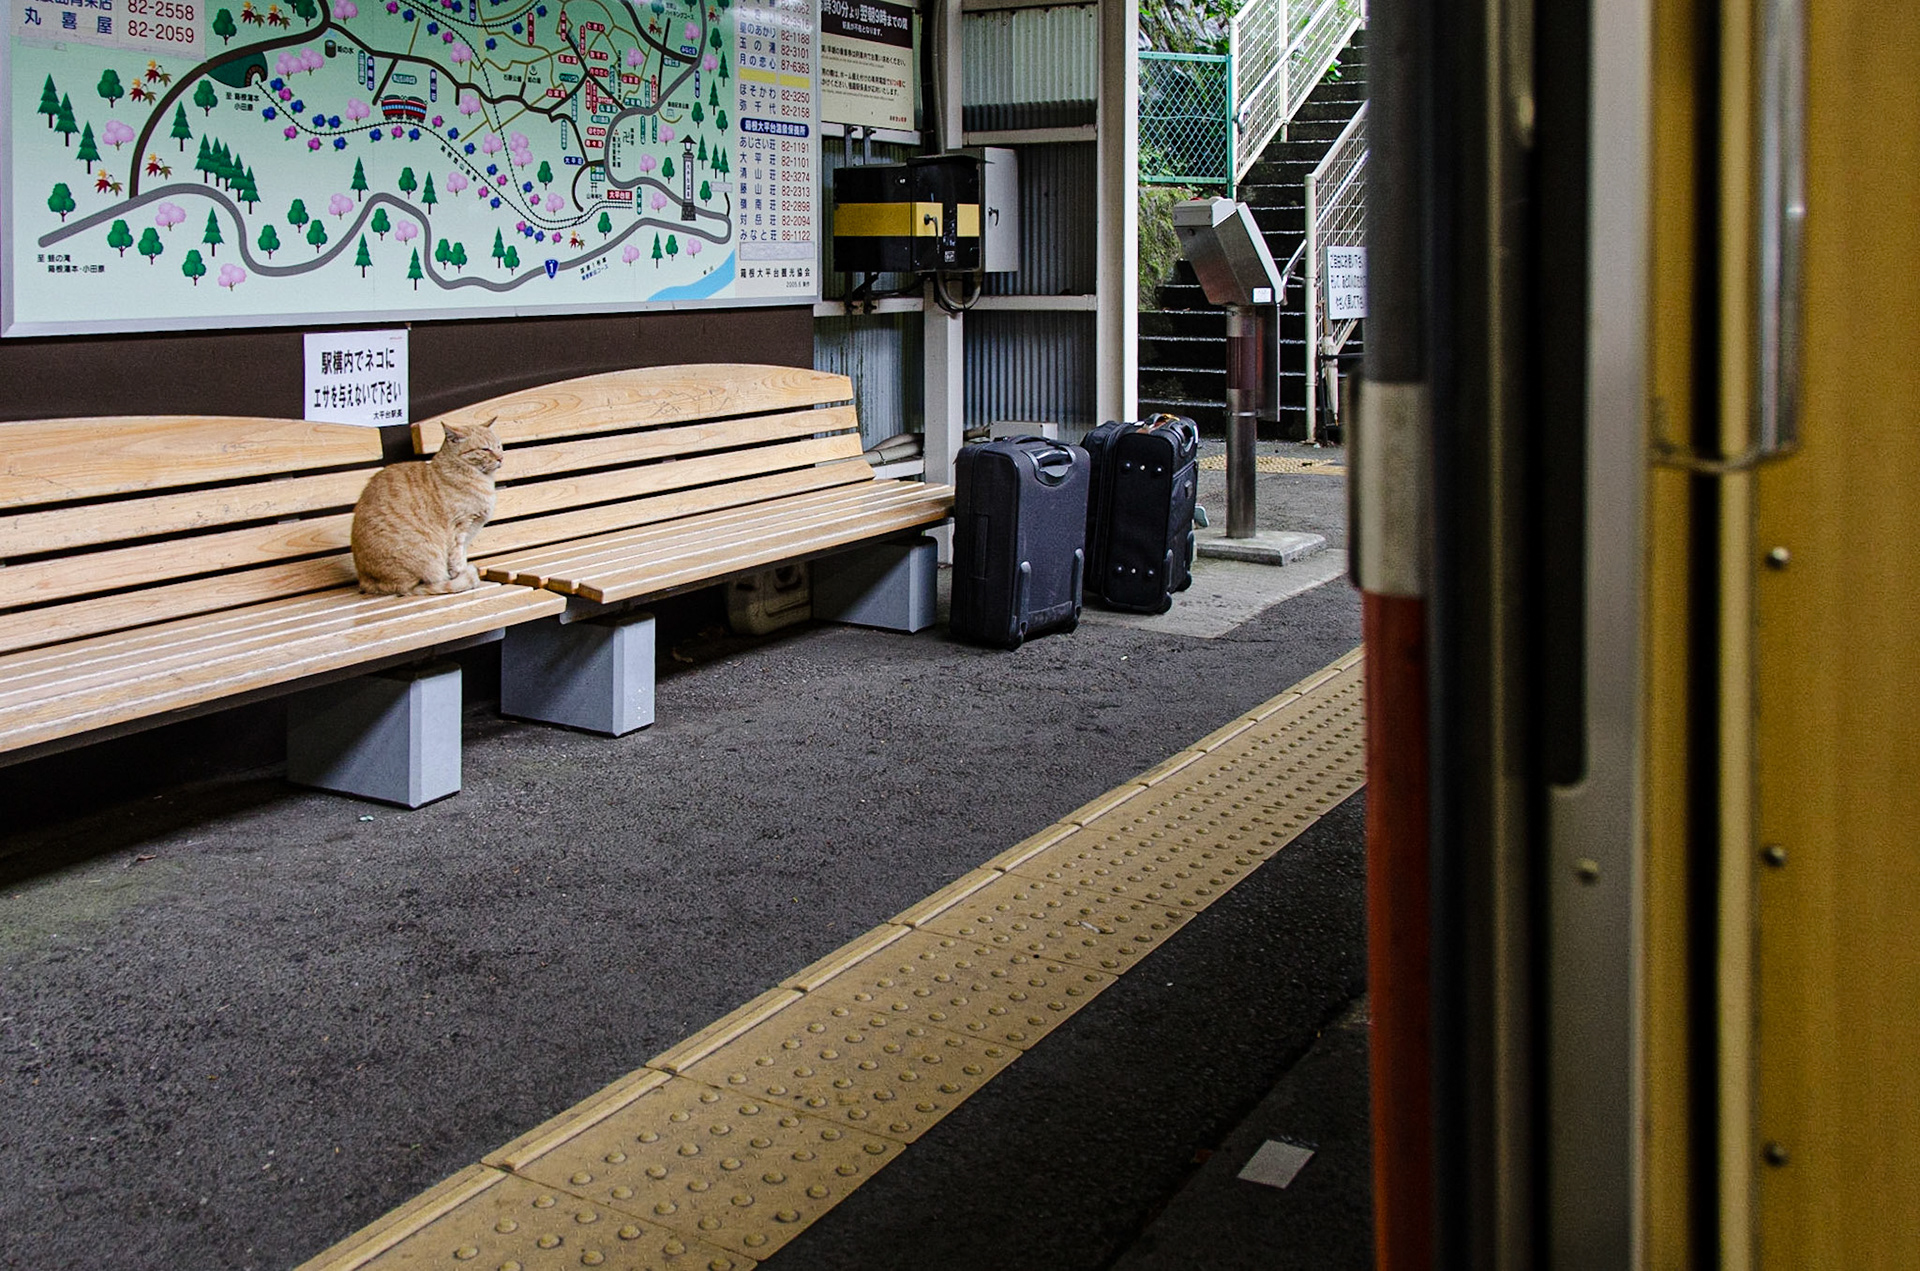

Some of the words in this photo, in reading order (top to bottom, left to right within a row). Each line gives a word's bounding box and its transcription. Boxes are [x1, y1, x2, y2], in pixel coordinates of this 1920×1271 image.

[128, 0, 194, 21] 82-2558
[25, 7, 113, 35] 丸喜屋
[128, 20, 194, 43] 82-2059
[739, 22, 776, 39] 星のあかり
[780, 30, 810, 45] 82-1188
[780, 45, 810, 59] 82-3101
[739, 53, 776, 70] 月の恋心
[780, 60, 810, 74] 87-6363
[739, 84, 777, 99] ほそかわ
[780, 90, 811, 104] 82-3250
[739, 99, 777, 115] 弥千代
[780, 105, 811, 118] 82-2158
[739, 136, 777, 151] あじさい荘
[780, 140, 810, 154] 82-1191
[739, 151, 777, 166] 大平荘
[780, 156, 810, 168] 82-1101
[781, 171, 811, 183] 82-3274
[609, 191, 632, 199] 大平台駅
[781, 186, 811, 198] 82-2313
[781, 200, 811, 212] 82-2898
[781, 215, 811, 227] 82-2094
[740, 229, 778, 241] みなと荘
[781, 230, 811, 242] 86-1122
[321, 348, 396, 375] 駅構内でネコに
[314, 381, 402, 408] エサを与えないで下さい
